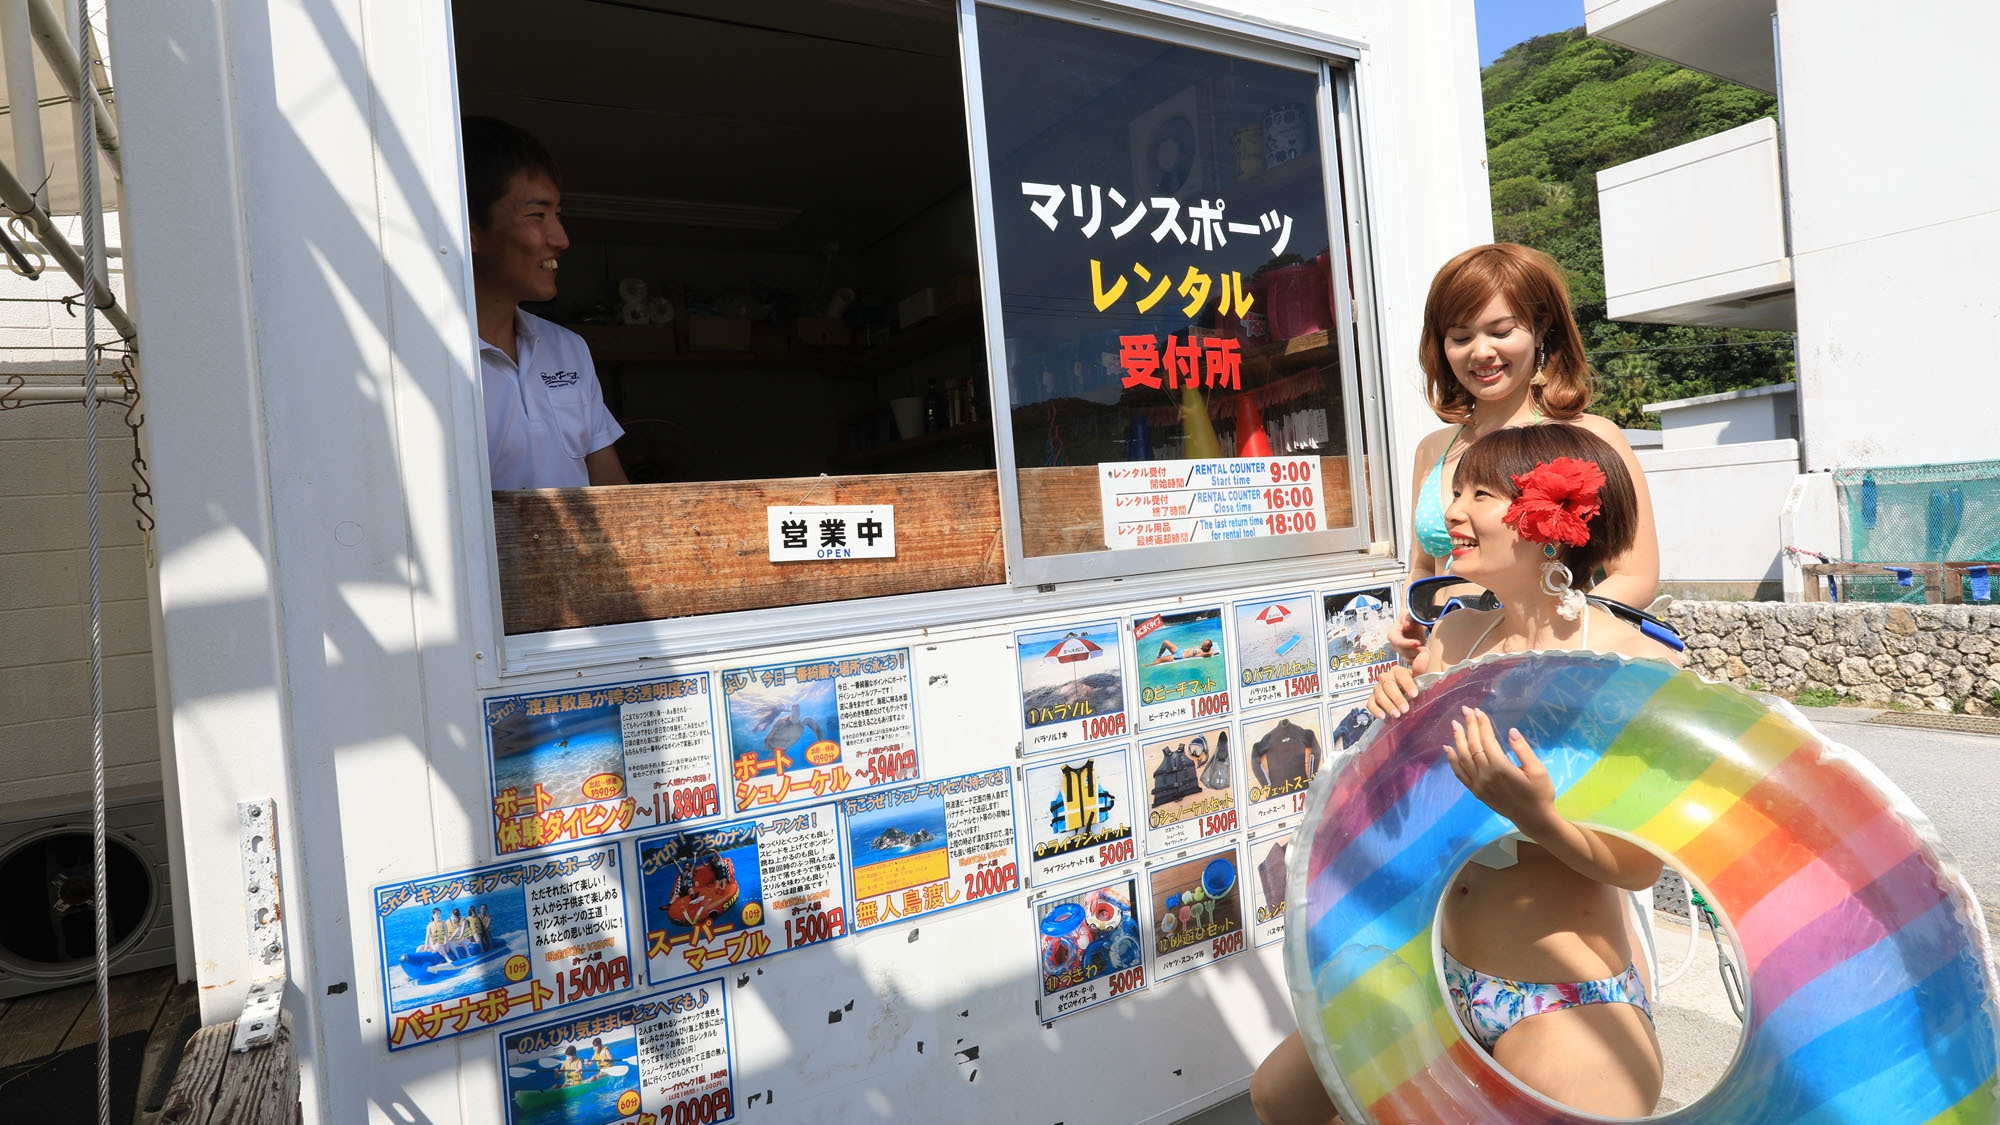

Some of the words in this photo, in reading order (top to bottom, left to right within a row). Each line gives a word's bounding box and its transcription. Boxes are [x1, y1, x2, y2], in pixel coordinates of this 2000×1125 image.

[1021, 181, 1293, 257] マリンスポーツ
[1090, 259, 1254, 319] レンタル
[1119, 334, 1241, 390] 受付所
[1113, 467, 1167, 479] レンタル受付
[1195, 463, 1228, 475] RENTAL
[1230, 462, 1265, 474] COUNTER
[1211, 475, 1230, 487] Start
[1232, 475, 1250, 485] time
[1270, 461, 1310, 483] 9:00
[1150, 477, 1184, 489] 開始時間
[1197, 492, 1227, 503] RENTAL
[1229, 490, 1261, 501] COUNTER
[1116, 495, 1168, 507] レンタル受付
[1214, 503, 1234, 513] Close
[1236, 502, 1252, 512] time
[1263, 486, 1313, 509] 16:00
[1152, 506, 1186, 517] 終了時間
[1200, 519, 1212, 530] The
[1214, 519, 1227, 529] last
[1228, 517, 1247, 529] return
[1248, 516, 1263, 527] time
[1265, 511, 1316, 535] 18:00
[781, 518, 882, 548] 営業中
[1118, 522, 1171, 535] レンタル用品
[1136, 533, 1188, 546] 最終返却時間
[1211, 530, 1221, 540] for
[1221, 529, 1242, 540] rental
[1243, 528, 1256, 538] tool
[817, 549, 851, 558] OPEN
[1284, 674, 1320, 698] 1,500円
[1190, 692, 1230, 718] 1,000円
[1034, 731, 1068, 744] パラソル1本
[1082, 712, 1127, 741] 1,000円
[734, 747, 792, 782] ボート
[736, 766, 852, 812] シュノーケル
[1250, 772, 1318, 802] ⑧ウェットスー
[494, 783, 553, 819] ボート
[496, 797, 637, 852] 体験ダイビング
[1198, 809, 1238, 838] 1,500円
[1100, 838, 1135, 868] 500円
[965, 862, 1018, 901] 2,000円
[533, 888, 618, 917] 大人から子供まで楽しめる
[745, 909, 760, 920] 10分
[856, 881, 961, 928] 無人島渡し
[647, 919, 735, 960] スーパー
[784, 906, 845, 949] 1,500円
[683, 930, 771, 972] マーブル
[1213, 930, 1244, 958] 500円
[508, 962, 527, 974] 10分
[556, 956, 630, 1004] 1,500円
[1109, 966, 1144, 997] 500円
[391, 978, 553, 1045] バナナボート
[620, 1098, 638, 1110] 60分
